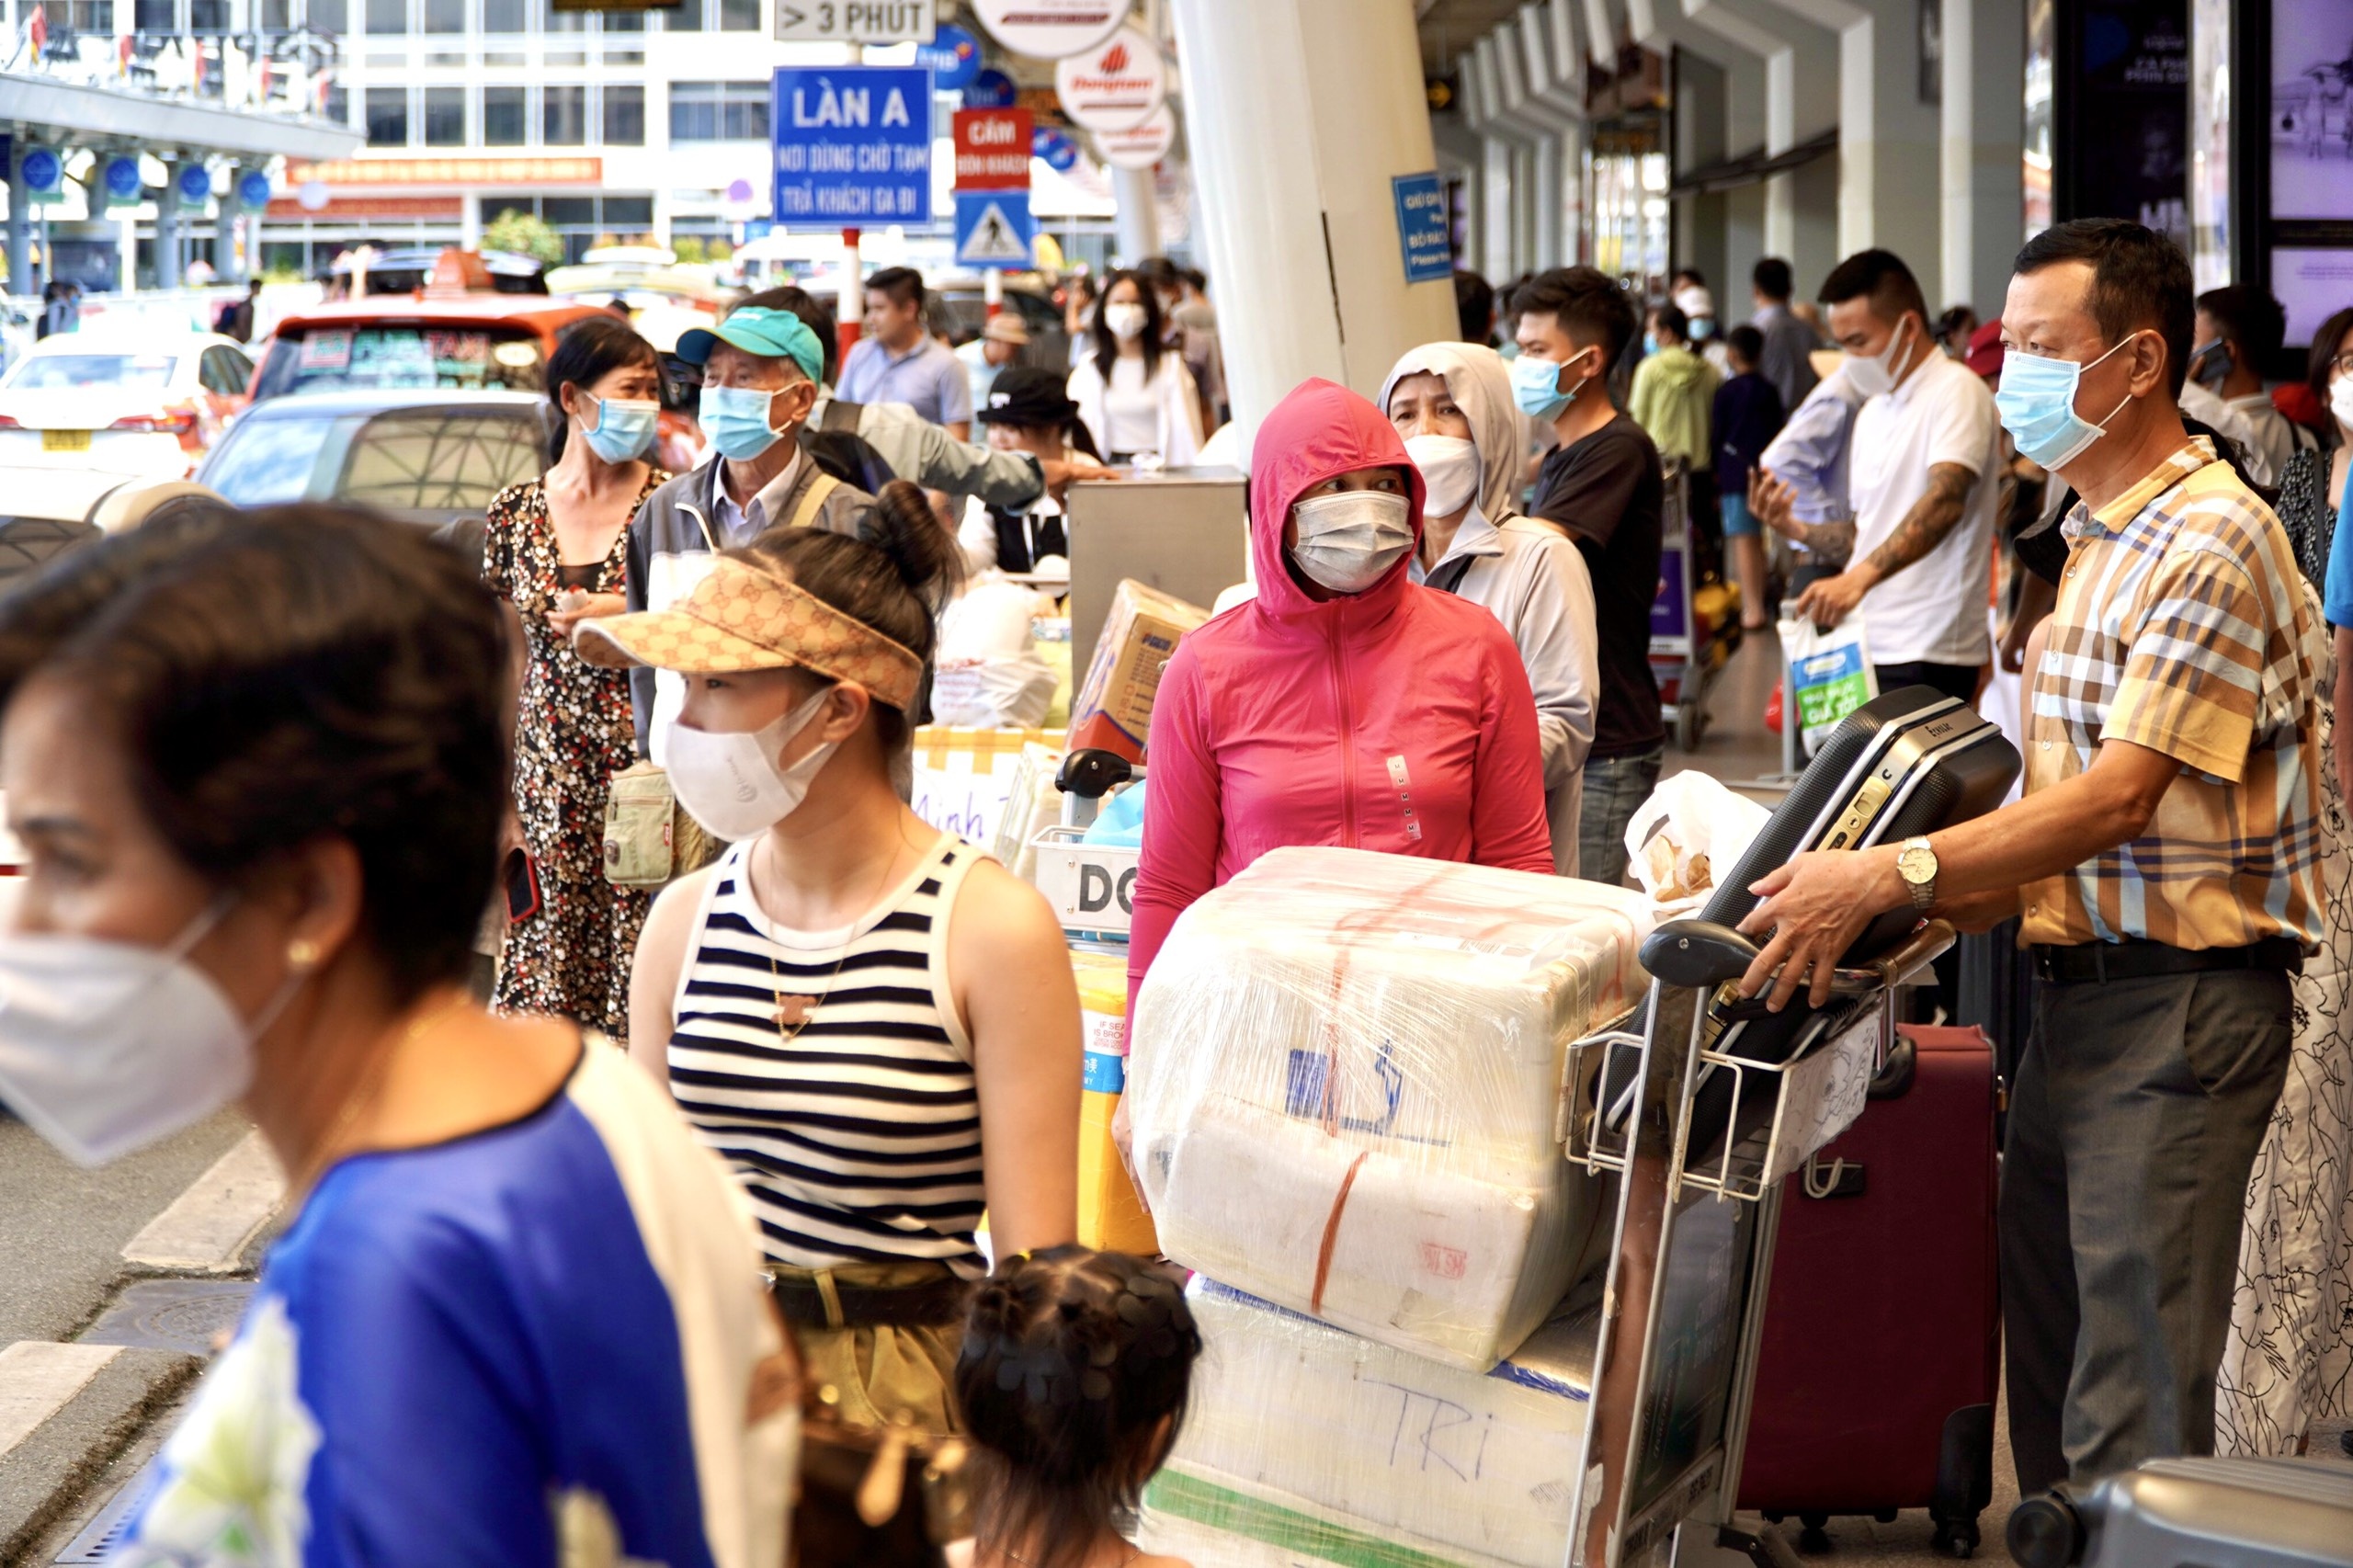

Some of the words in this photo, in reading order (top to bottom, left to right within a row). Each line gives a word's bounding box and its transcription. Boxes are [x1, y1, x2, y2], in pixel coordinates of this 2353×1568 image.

[817, 3, 835, 33] 3
[793, 76, 870, 128] LÀN
[881, 86, 910, 128] A
[1094, 1028, 1101, 1037] IS
